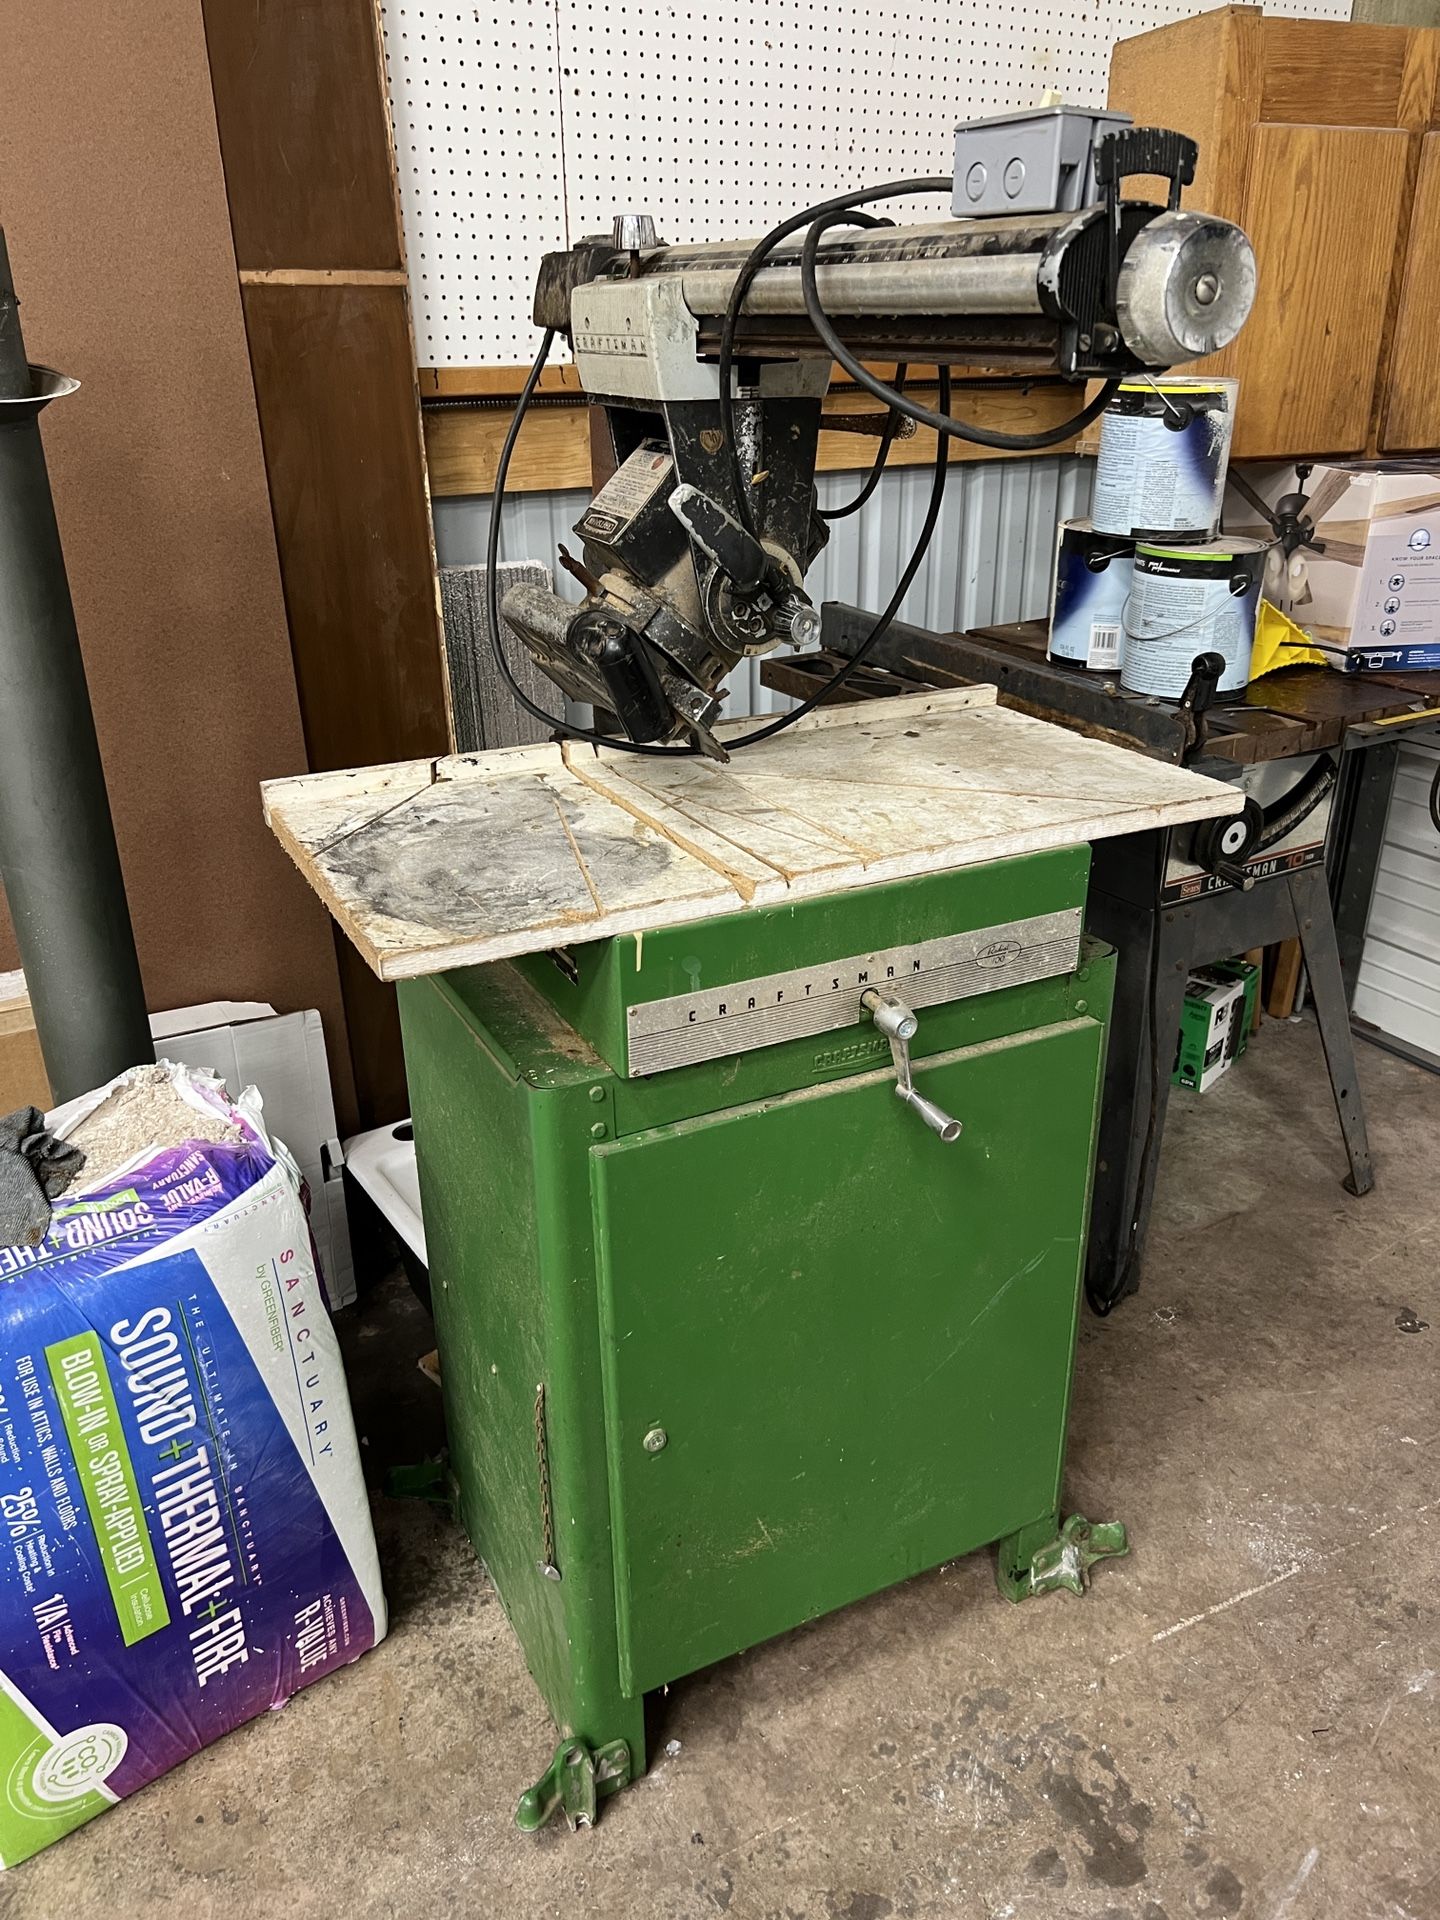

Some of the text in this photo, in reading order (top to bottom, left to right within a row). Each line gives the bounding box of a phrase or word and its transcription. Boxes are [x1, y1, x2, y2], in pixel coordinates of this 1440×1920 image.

[575, 336, 647, 351] CRAFTSMAN
[1285, 852, 1305, 868] 10
[1182, 884, 1201, 895] Sears
[688, 959, 922, 1023] CRAFTSMAN
[814, 1038, 890, 1067] CRAFTSMA
[152, 1150, 205, 1190] SANCTUARY
[65, 1201, 155, 1249] SOUND
[203, 1189, 286, 1233] SANCTUARY
[255, 1263, 267, 1281] by
[110, 1306, 197, 1446] SOUND
[188, 1293, 205, 1330] THE
[202, 1346, 231, 1441] ULTIMATE
[226, 1450, 239, 1473] IN
[4, 1423, 21, 1464] Reduction
[15, 1355, 78, 1531] FOR USE IN ATTICS, WALLS AND FLOORS
[61, 1348, 145, 1575] BLOW-IN OR SPRAY-APPLIED
[0, 1487, 42, 1538] 25%
[151, 1446, 235, 1617] THERMAL
[13, 1544, 28, 1574] Cooling
[25, 1539, 39, 1569] Heating
[36, 1534, 54, 1571] Reduction
[52, 1629, 63, 1643] Fire
[294, 1599, 328, 1674] R-VALUE
[322, 1593, 338, 1655] ACHIEVES ANY
[188, 1606, 249, 1688] FIRE
